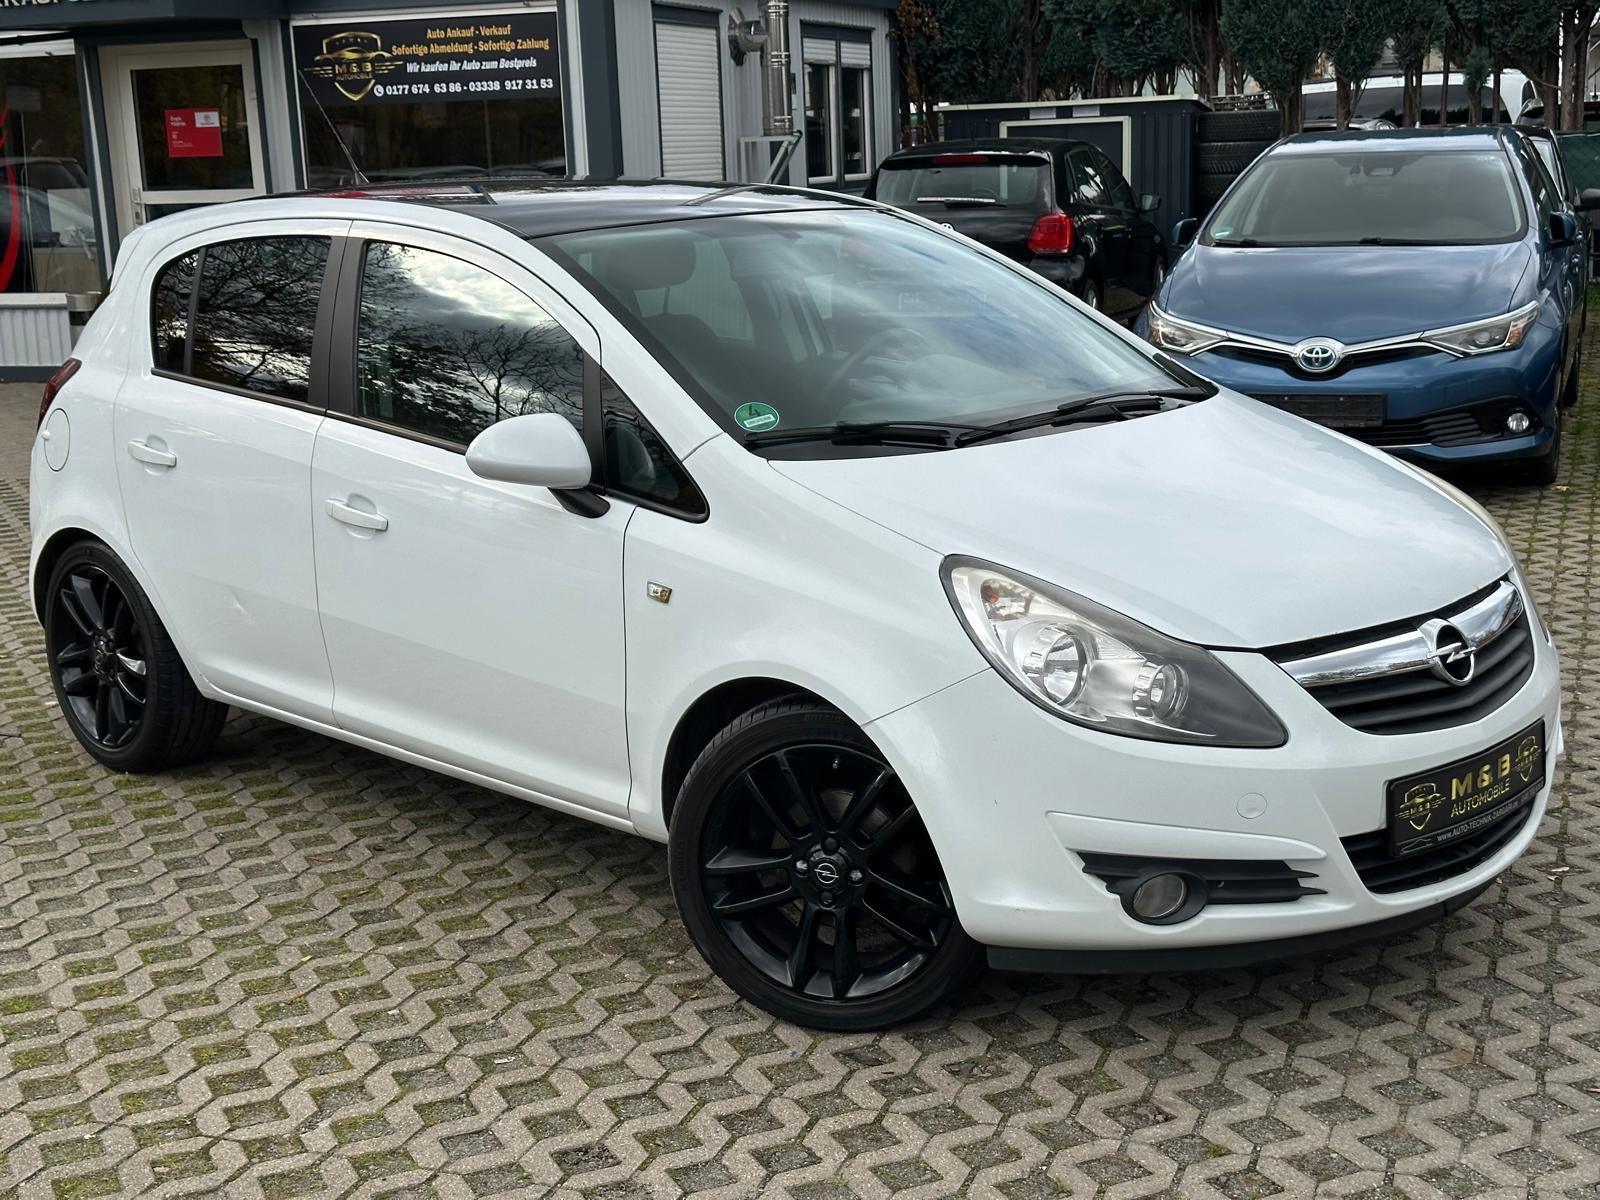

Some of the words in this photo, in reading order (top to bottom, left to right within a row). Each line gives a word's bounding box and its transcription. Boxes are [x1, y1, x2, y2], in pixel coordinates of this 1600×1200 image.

[426, 28, 445, 39] Auto
[446, 26, 474, 38] Ankauf
[479, 24, 511, 36] Verkauf
[391, 45, 428, 56] Sofortige
[429, 43, 473, 54] Abmeldung
[478, 40, 515, 52] Sofortige
[516, 38, 549, 50] Zahlung
[335, 64, 347, 74] M
[362, 62, 372, 72] B
[406, 62, 419, 73] Wir
[420, 60, 448, 72] kaufen
[449, 60, 461, 71] ihr
[461, 60, 480, 71] Auto
[481, 60, 498, 70] zum
[499, 56, 537, 70] Bestpreis
[335, 73, 373, 81] AUTOMOBILE
[386, 85, 409, 95] 0177
[411, 84, 430, 94] 674
[434, 83, 447, 93] 63
[448, 82, 462, 92] 86
[468, 80, 501, 92] 03338
[504, 79, 523, 90] 917
[525, 79, 538, 89] 31
[540, 78, 553, 89] 53
[1451, 771, 1474, 800] M
[1477, 763, 1494, 789] &
[1497, 753, 1511, 779] B
[1450, 777, 1511, 818] AUTOMOBILE
